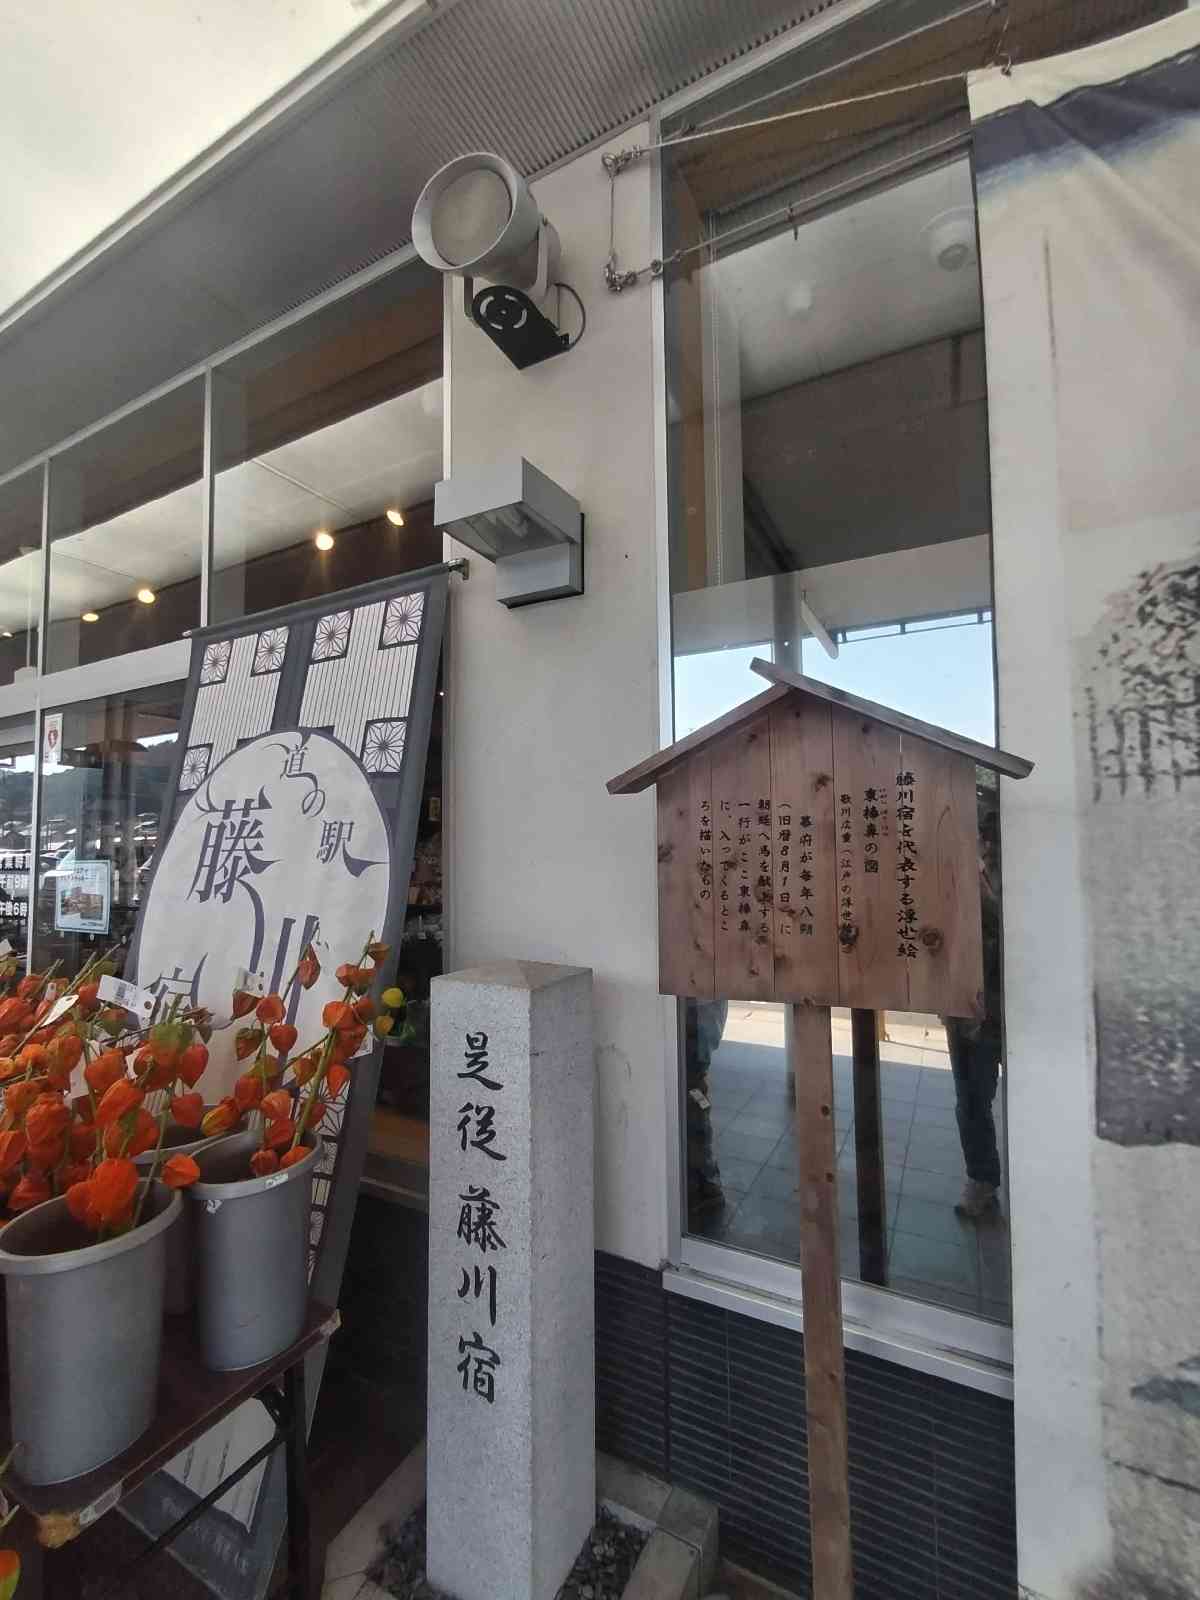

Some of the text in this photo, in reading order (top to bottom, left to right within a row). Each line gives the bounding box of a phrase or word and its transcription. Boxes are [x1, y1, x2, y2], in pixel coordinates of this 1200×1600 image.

[281, 743, 389, 878] 道の駅
[896, 771, 919, 959] 藤川宿を代表する浮世絵
